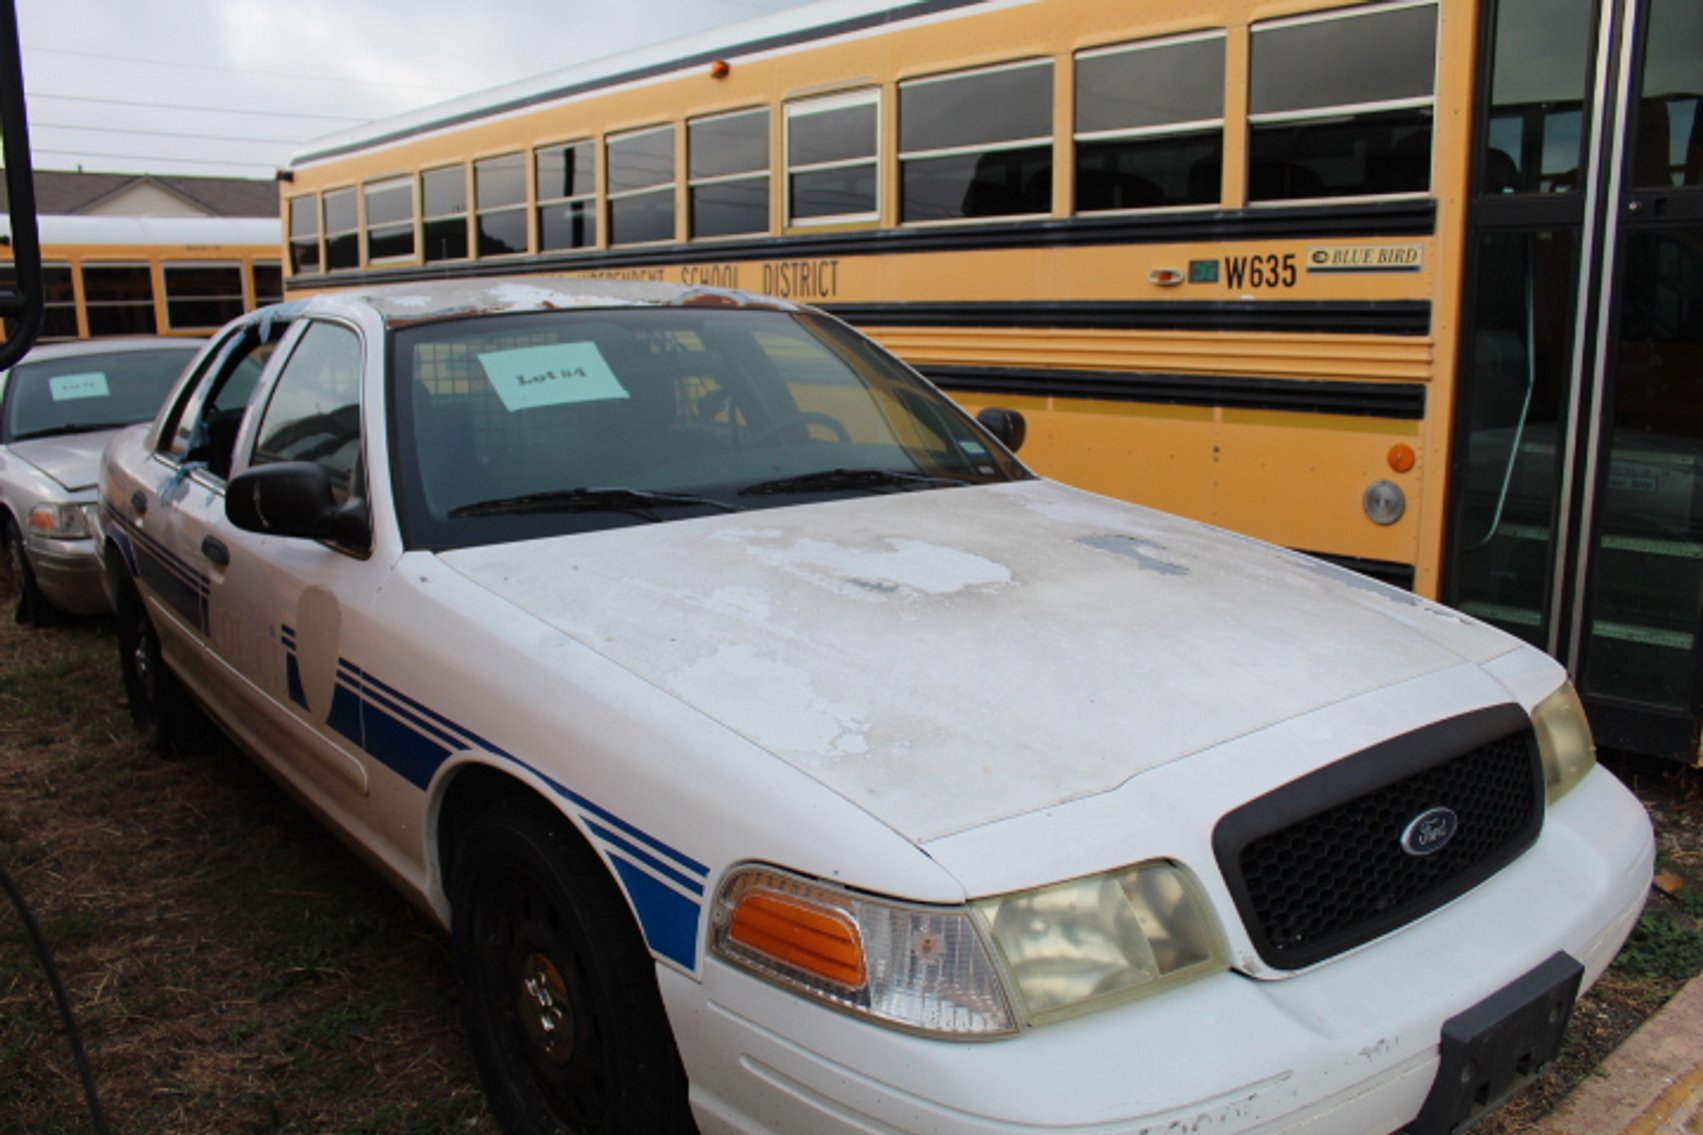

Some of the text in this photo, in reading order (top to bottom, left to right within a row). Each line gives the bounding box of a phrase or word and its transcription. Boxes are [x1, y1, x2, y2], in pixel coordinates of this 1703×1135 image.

[1331, 247, 1418, 264] BLUE BIRD
[763, 260, 838, 297] DISTRICT
[1225, 253, 1296, 289] W635
[515, 370, 557, 386] Lot
